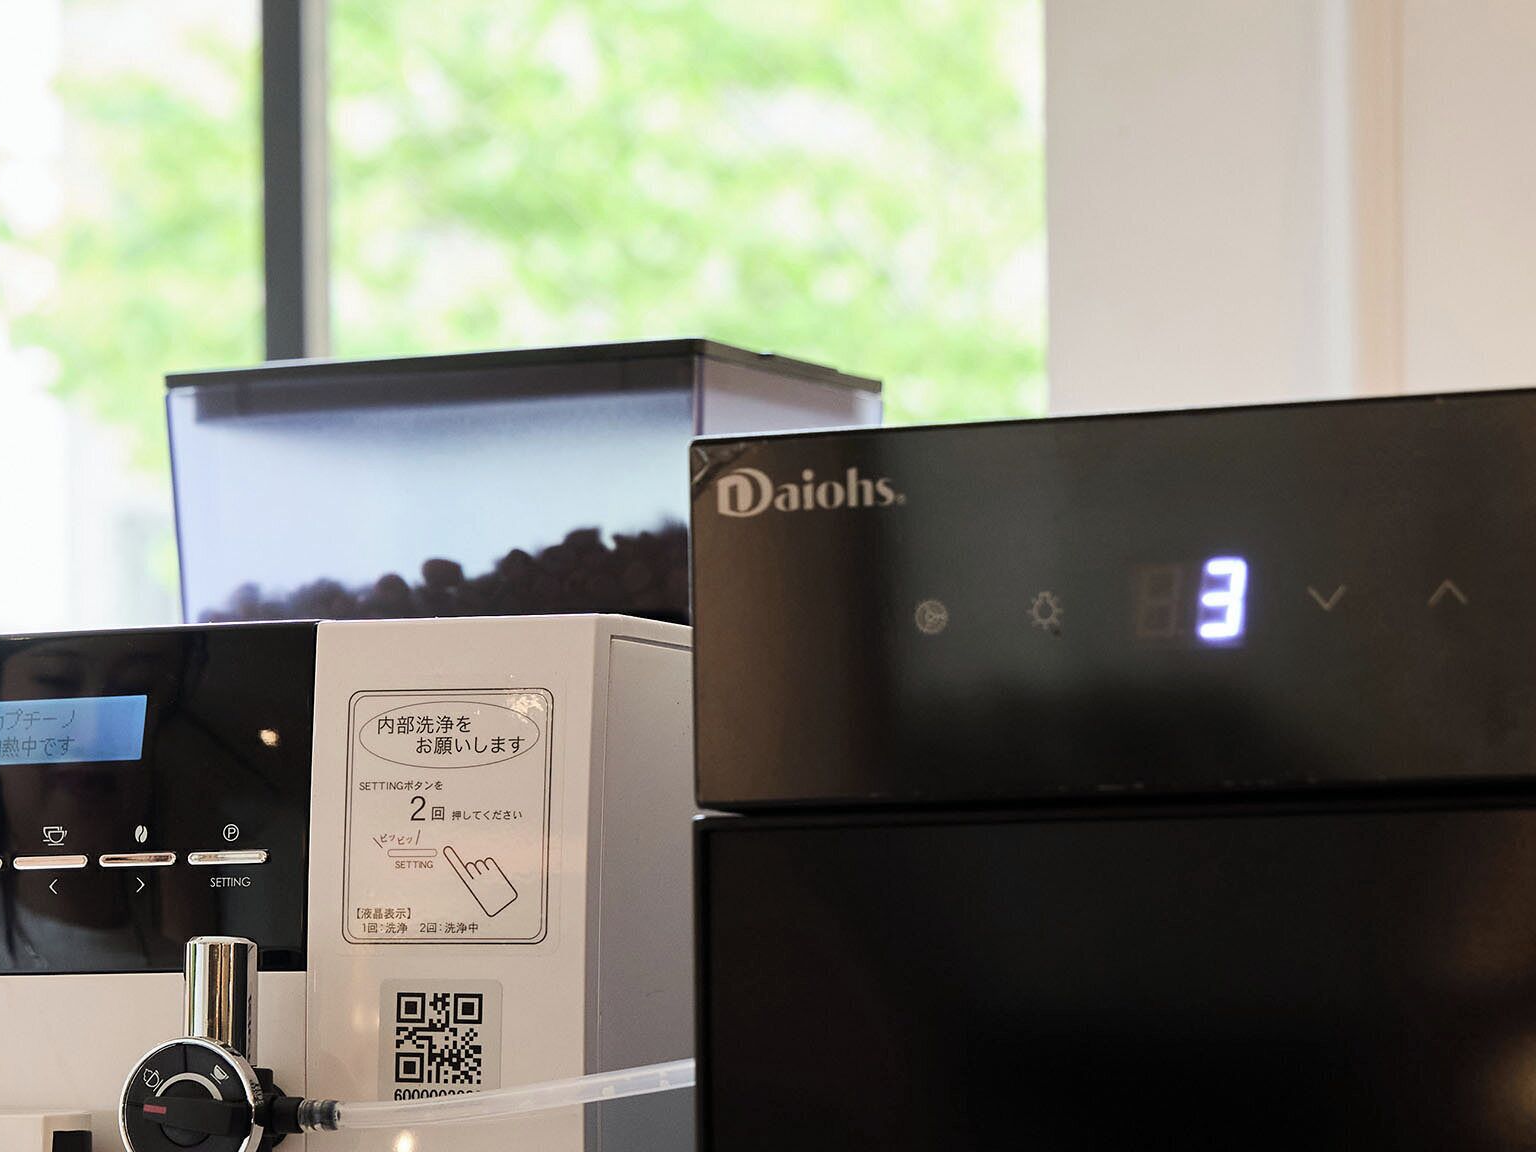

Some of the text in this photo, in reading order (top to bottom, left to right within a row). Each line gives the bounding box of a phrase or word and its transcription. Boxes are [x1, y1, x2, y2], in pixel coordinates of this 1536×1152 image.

[716, 466, 897, 518] Daiohs
[1198, 556, 1249, 640] 3
[376, 715, 472, 735] 内部洗浄を
[415, 735, 526, 755] お願いします
[359, 781, 443, 792] SETTINGボタンを
[451, 810, 523, 821] 押してください
[394, 861, 434, 870] SETTING
[210, 877, 251, 888] SETTING
